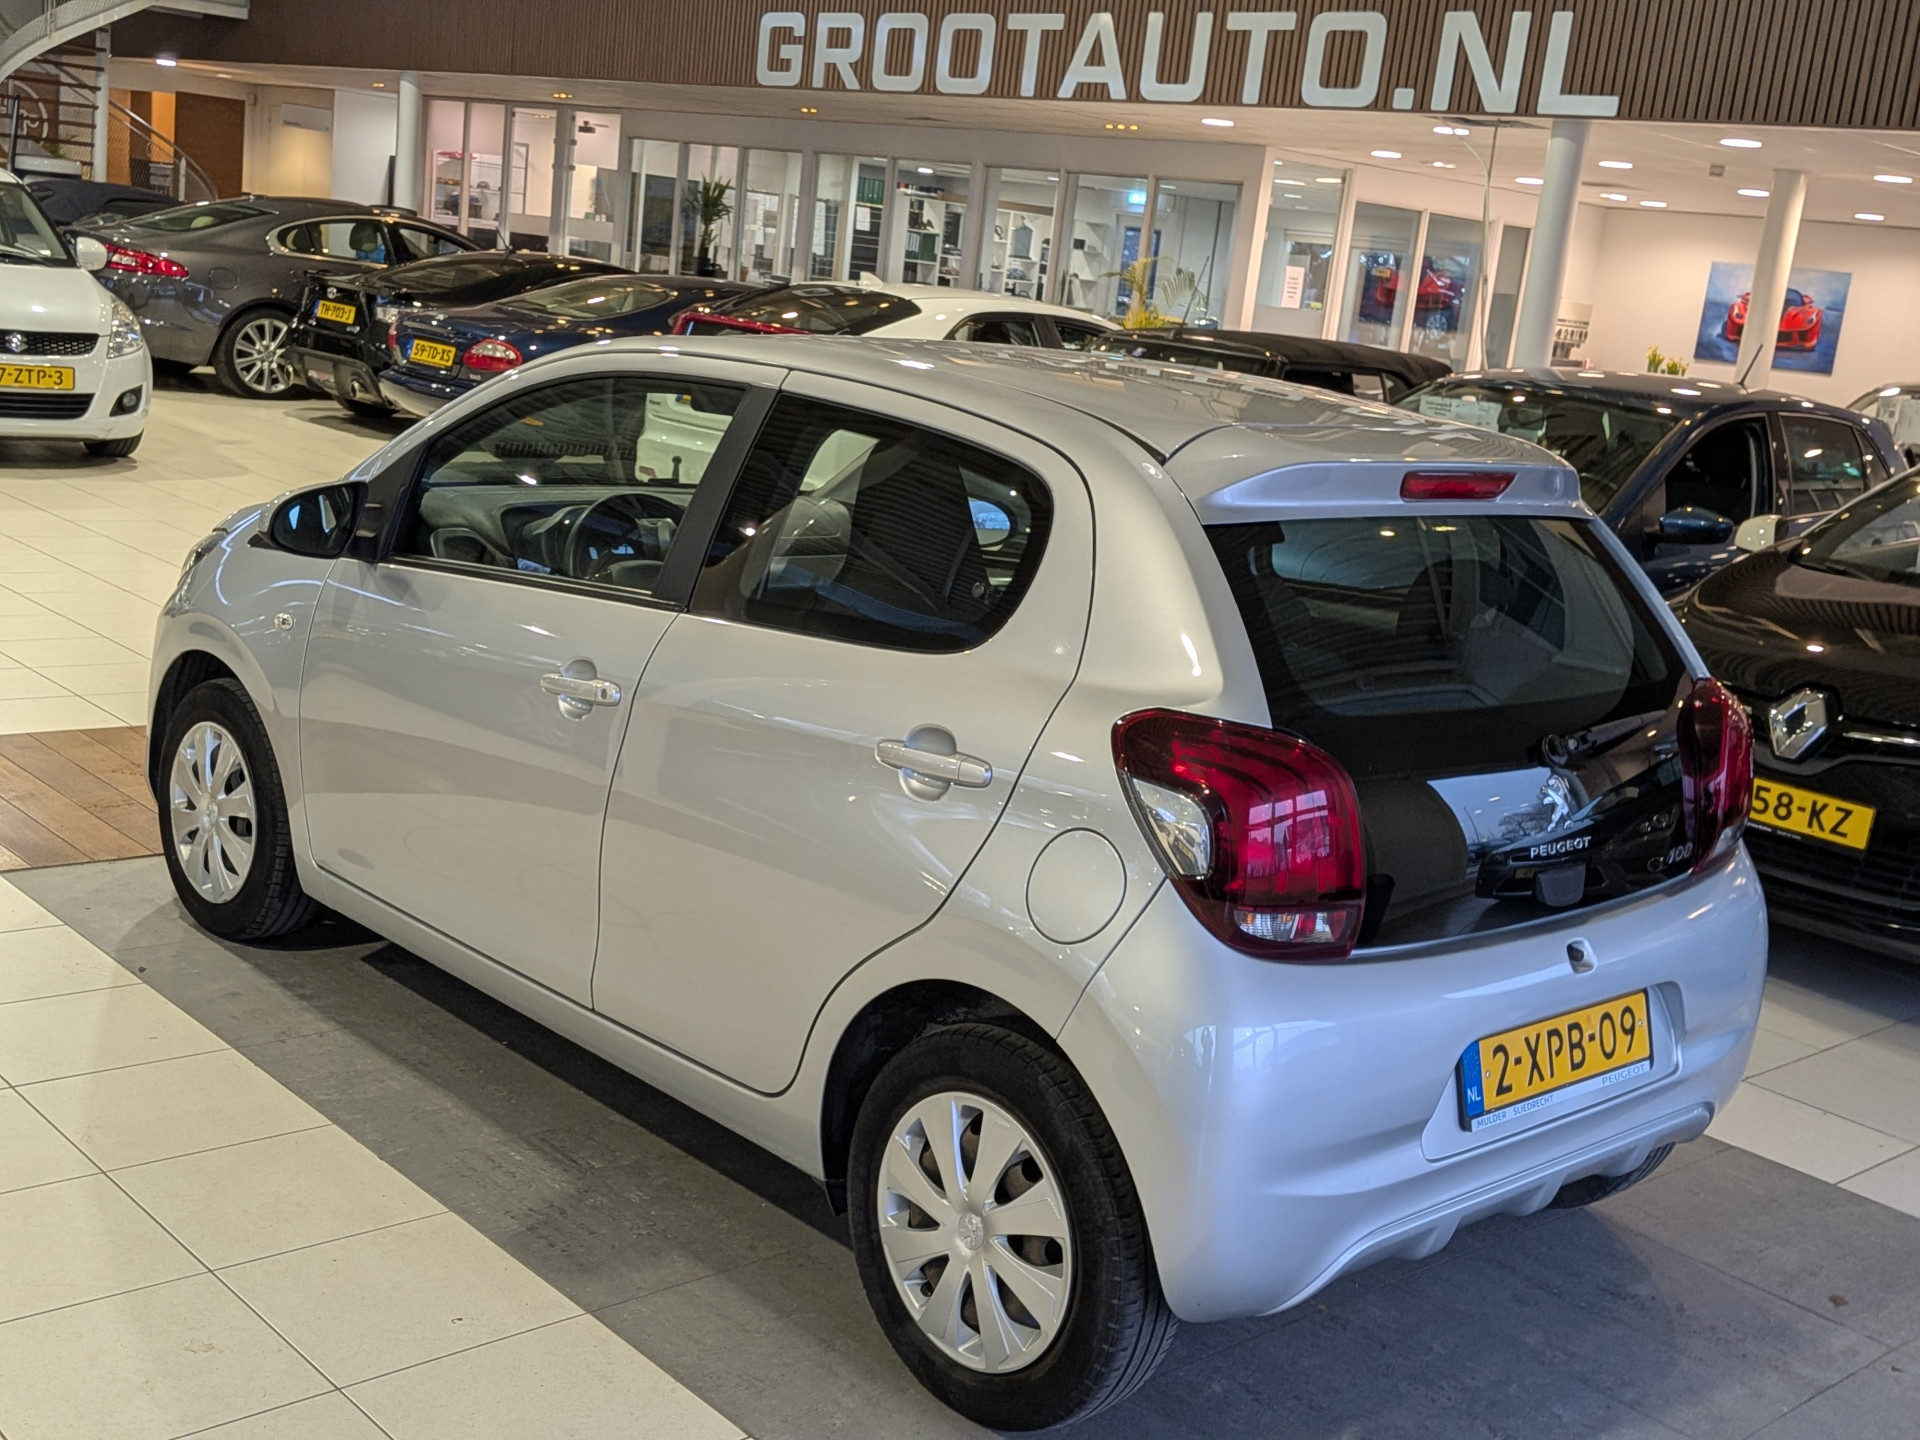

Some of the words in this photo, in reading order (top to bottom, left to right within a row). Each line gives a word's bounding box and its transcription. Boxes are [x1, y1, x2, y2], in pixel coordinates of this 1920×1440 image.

[757, 10, 1619, 118] GROOTAUTO.NL
[413, 342, 452, 363] 59-TD-XS
[0, 367, 64, 386] 7-ZTP-3
[1751, 784, 1854, 839] 58-KZ
[1530, 836, 1592, 859] PEUGEOT
[1492, 1005, 1636, 1098] 2-XPB-09
[1601, 1063, 1646, 1086] PEUGEOT
[1467, 1088, 1482, 1104] NL
[1477, 1110, 1507, 1129] MULDER
[1512, 1094, 1554, 1117] SLIEDRECHT
